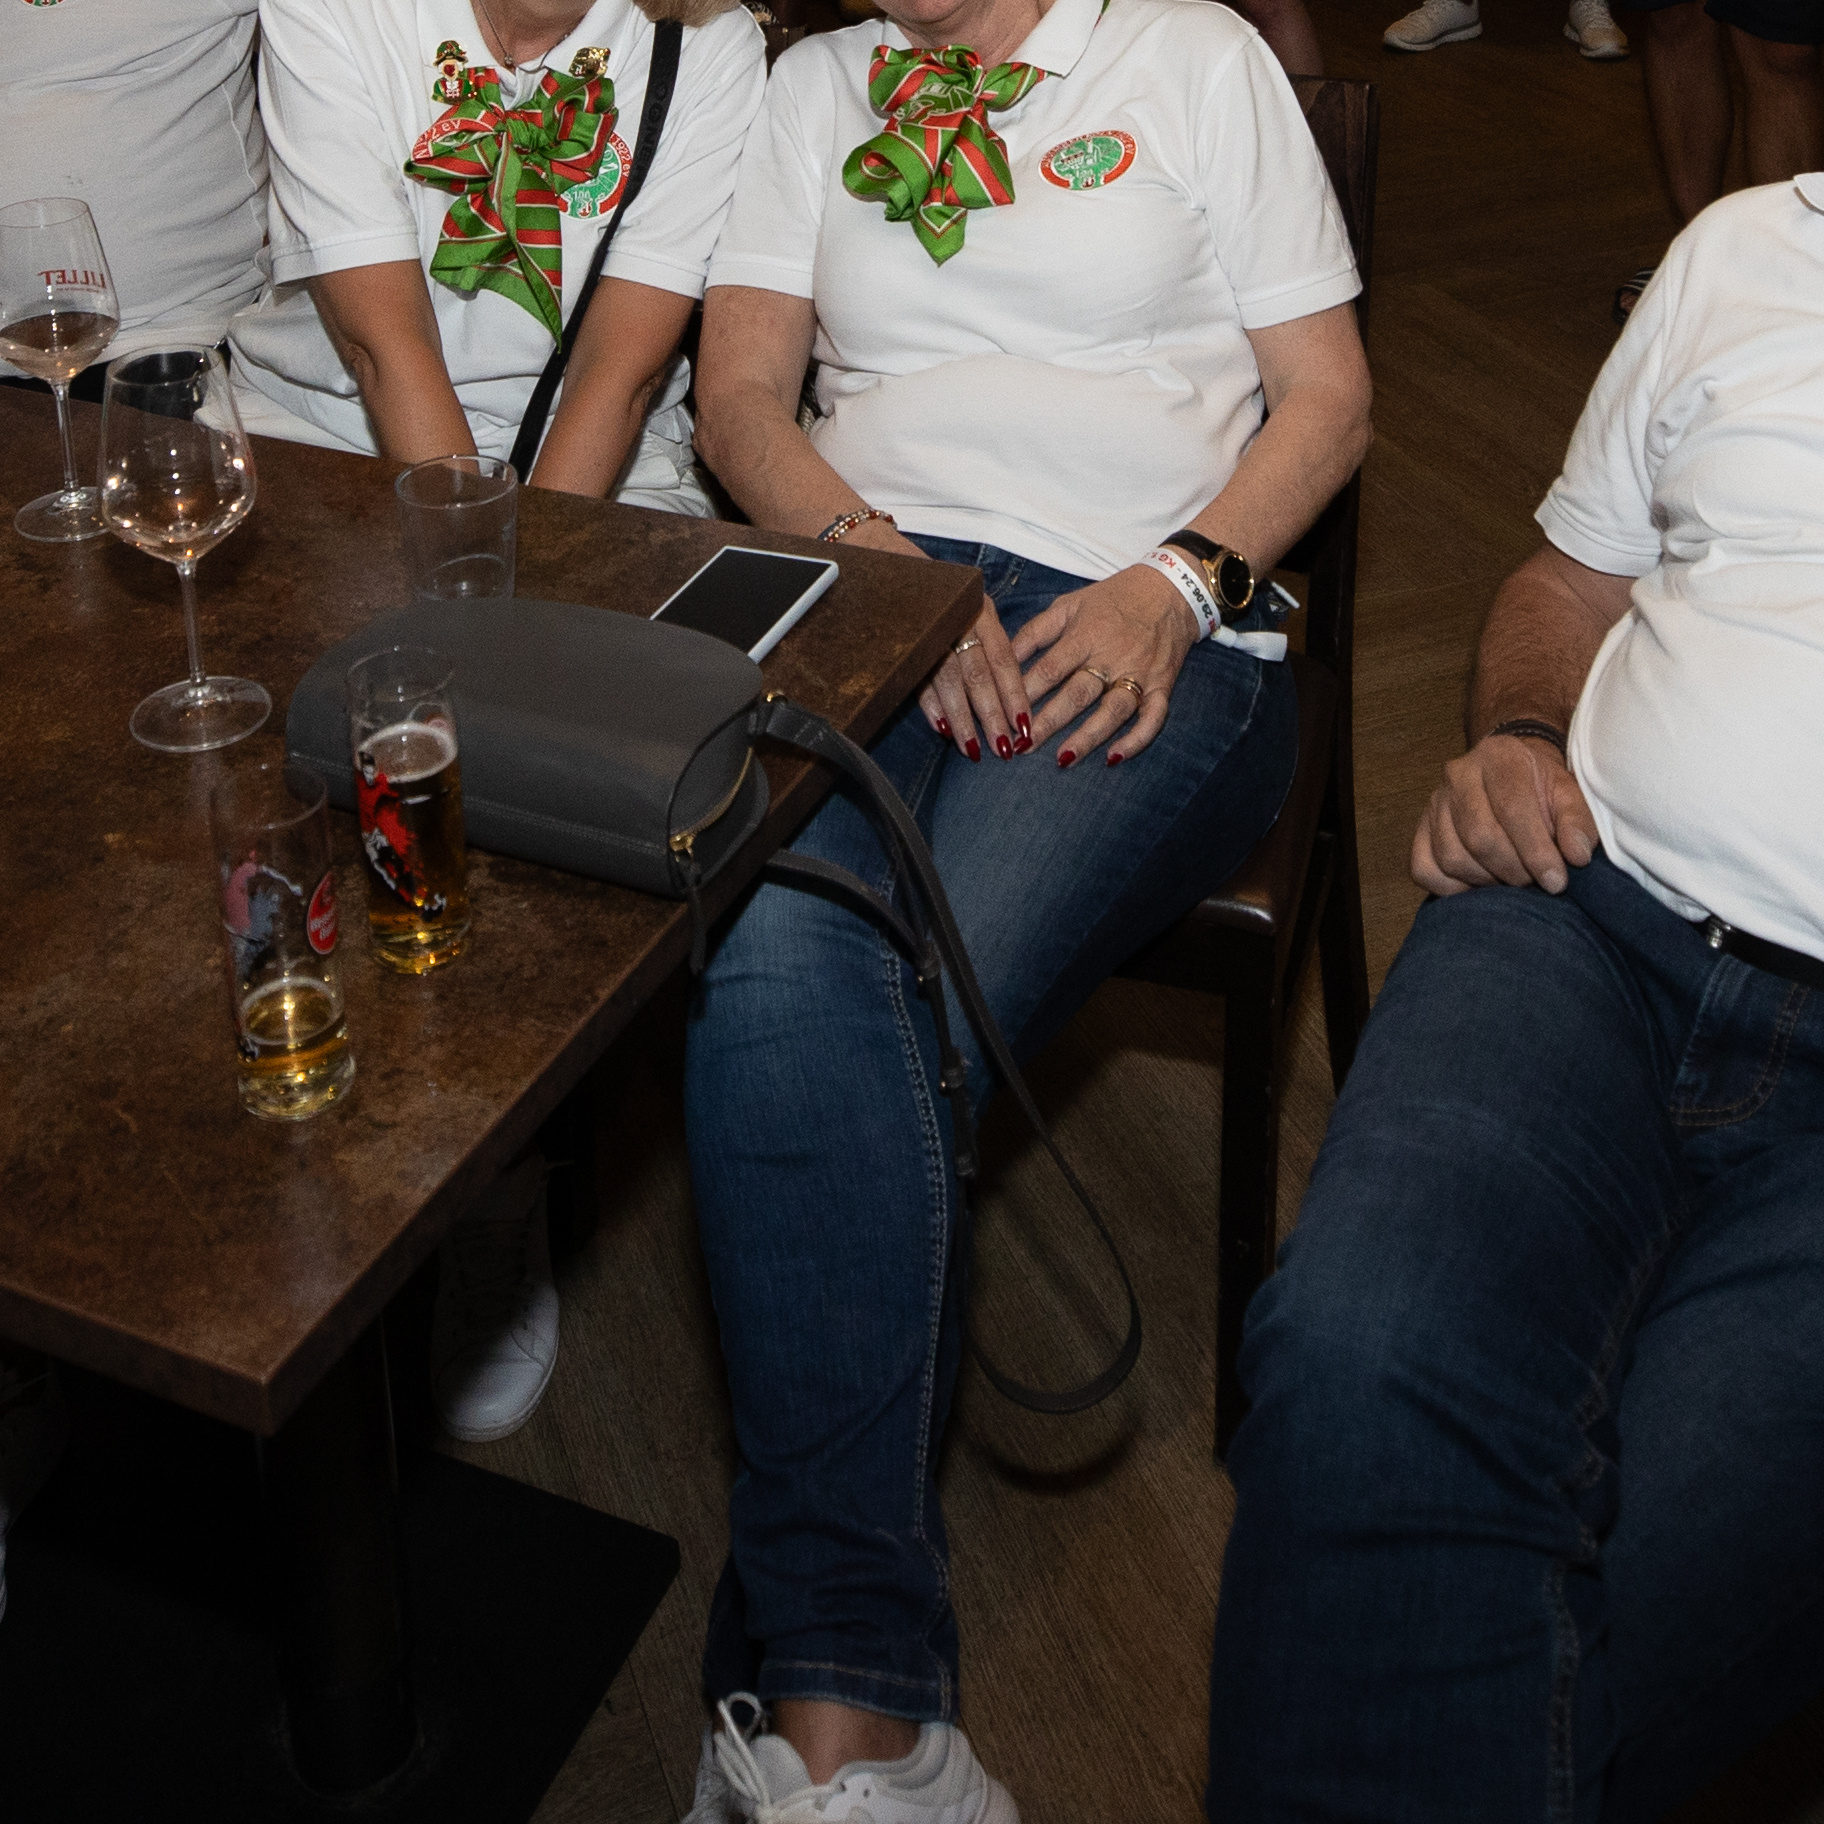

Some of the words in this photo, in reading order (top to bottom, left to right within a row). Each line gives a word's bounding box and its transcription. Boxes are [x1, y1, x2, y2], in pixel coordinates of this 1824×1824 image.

[614, 138, 632, 162] 1922
[1158, 553, 1176, 568] KG
[1181, 573, 1213, 619] 29.06.24
